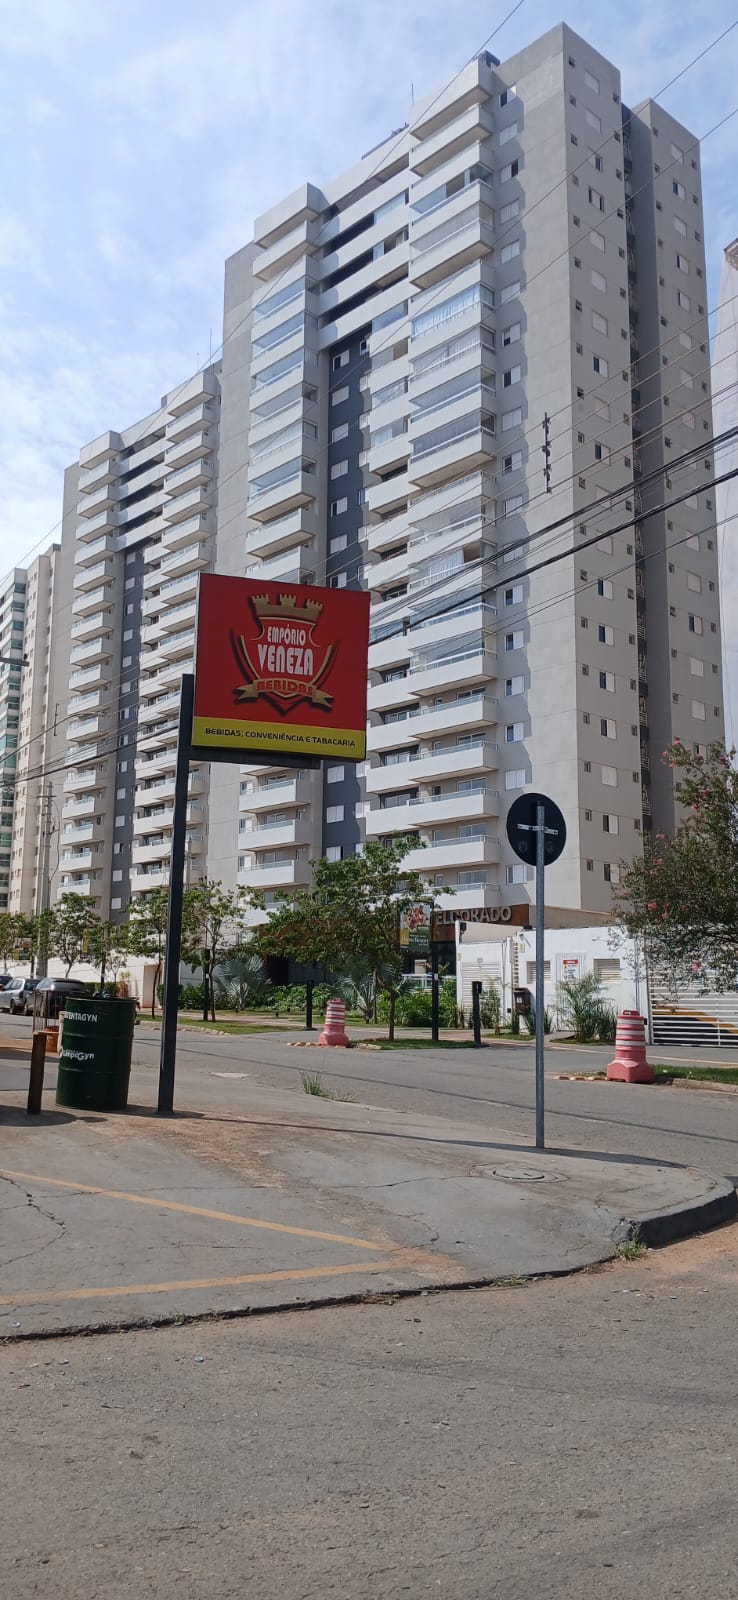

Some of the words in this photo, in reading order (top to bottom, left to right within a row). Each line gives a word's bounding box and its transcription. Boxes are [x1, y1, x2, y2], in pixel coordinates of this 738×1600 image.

[267, 624, 306, 646] EMPÓRIO
[257, 644, 313, 675] VENEZA
[255, 679, 314, 698] BEBIDAS
[205, 727, 244, 738] BEBIDAS,
[313, 736, 356, 747] TABACARIA
[435, 907, 512, 925] ELDORADO
